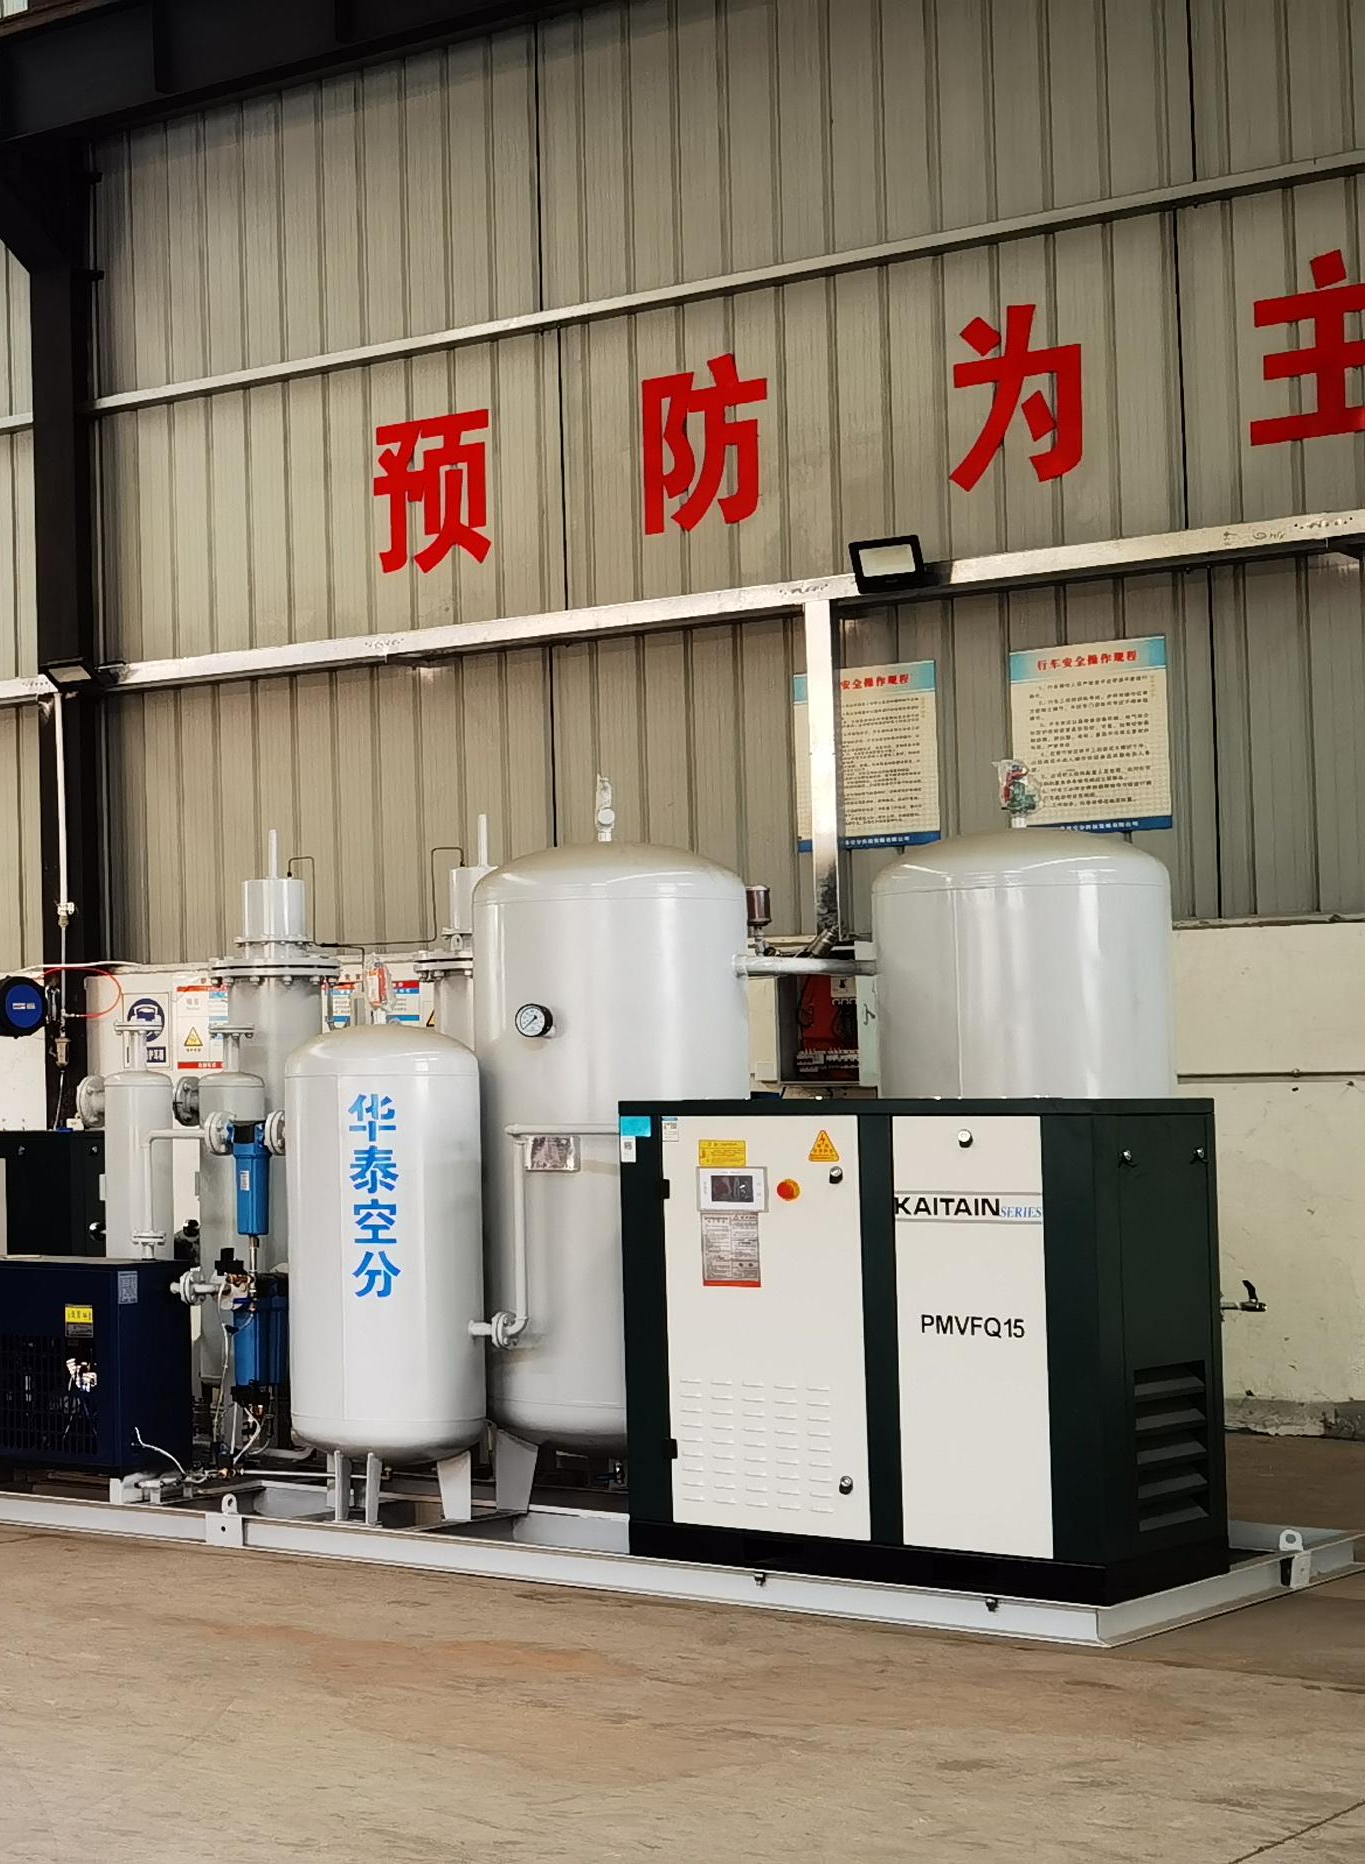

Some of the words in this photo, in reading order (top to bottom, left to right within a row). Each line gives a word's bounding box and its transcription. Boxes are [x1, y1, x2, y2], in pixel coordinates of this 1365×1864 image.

[373, 249, 1365, 574] 预防为主
[1037, 650, 1137, 671] 行车安全操作规程
[840, 674, 911, 691] 安全操作规程
[348, 1094, 401, 1297] 华泰空分
[894, 1196, 1001, 1217] KAITAIN
[1000, 1206, 1042, 1219] SERIES
[921, 1314, 1025, 1338] PMVFQ15
